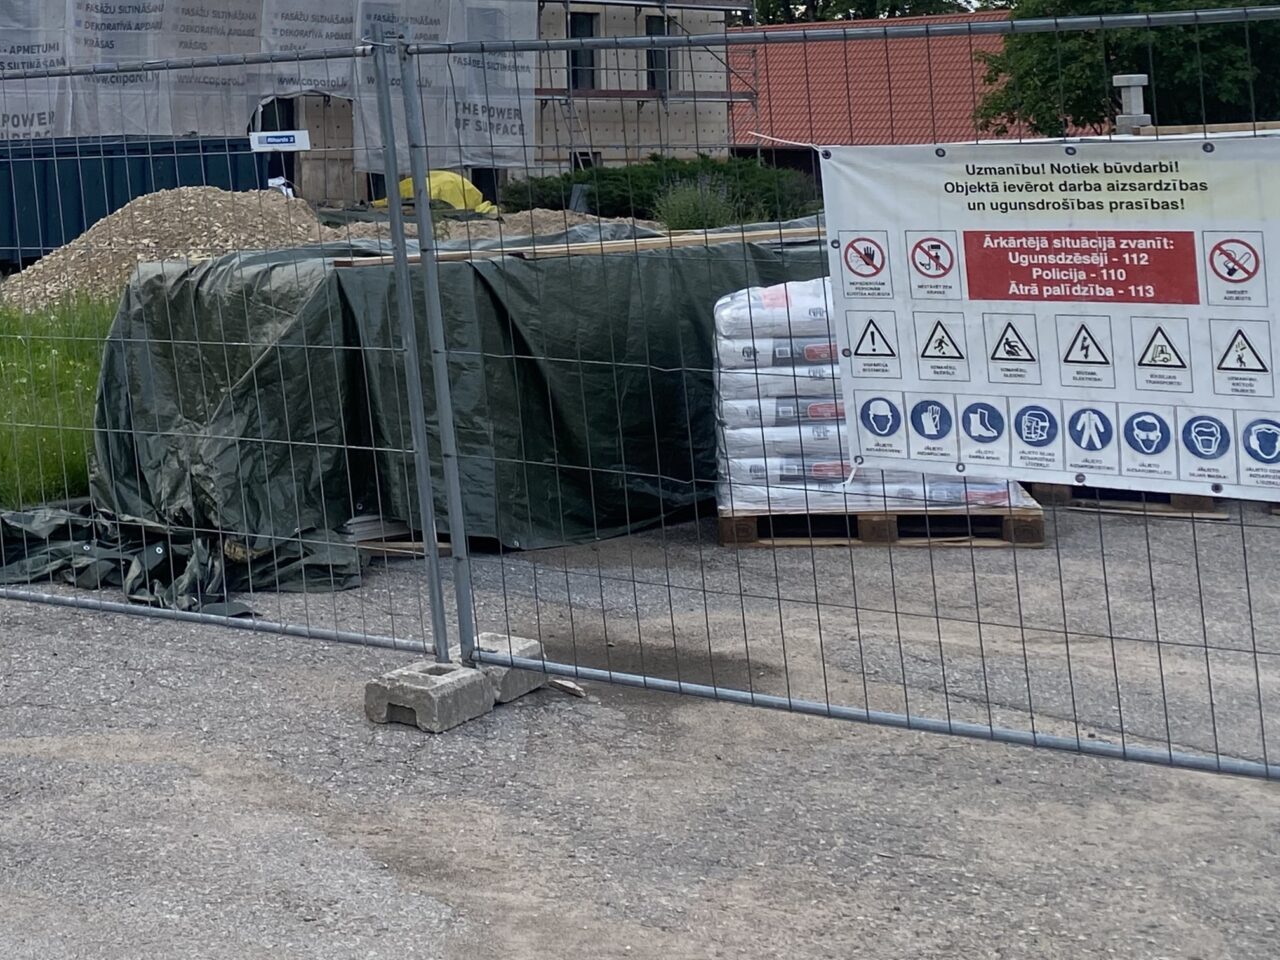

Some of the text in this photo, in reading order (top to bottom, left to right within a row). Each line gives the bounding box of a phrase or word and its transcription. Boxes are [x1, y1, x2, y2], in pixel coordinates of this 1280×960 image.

[455, 102, 520, 120] THE POWER
[965, 161, 1179, 176] Uzmanību! Notiek būvdarbi!
[944, 179, 1208, 196] Objektā ievērot darba aizsardzības
[968, 198, 1185, 213] un ugunsdrošības prasības!
[983, 234, 1174, 251] Ārkārtējā situācijā zvanīt:
[1008, 252, 1108, 267] Ugunsdzēsēji
[1122, 253, 1149, 265] 112
[1032, 268, 1087, 282] Policija
[1100, 269, 1126, 281] 110
[1008, 281, 1039, 296] Ātrā
[1043, 283, 1115, 298] palīdzība
[1128, 286, 1155, 298] 113
